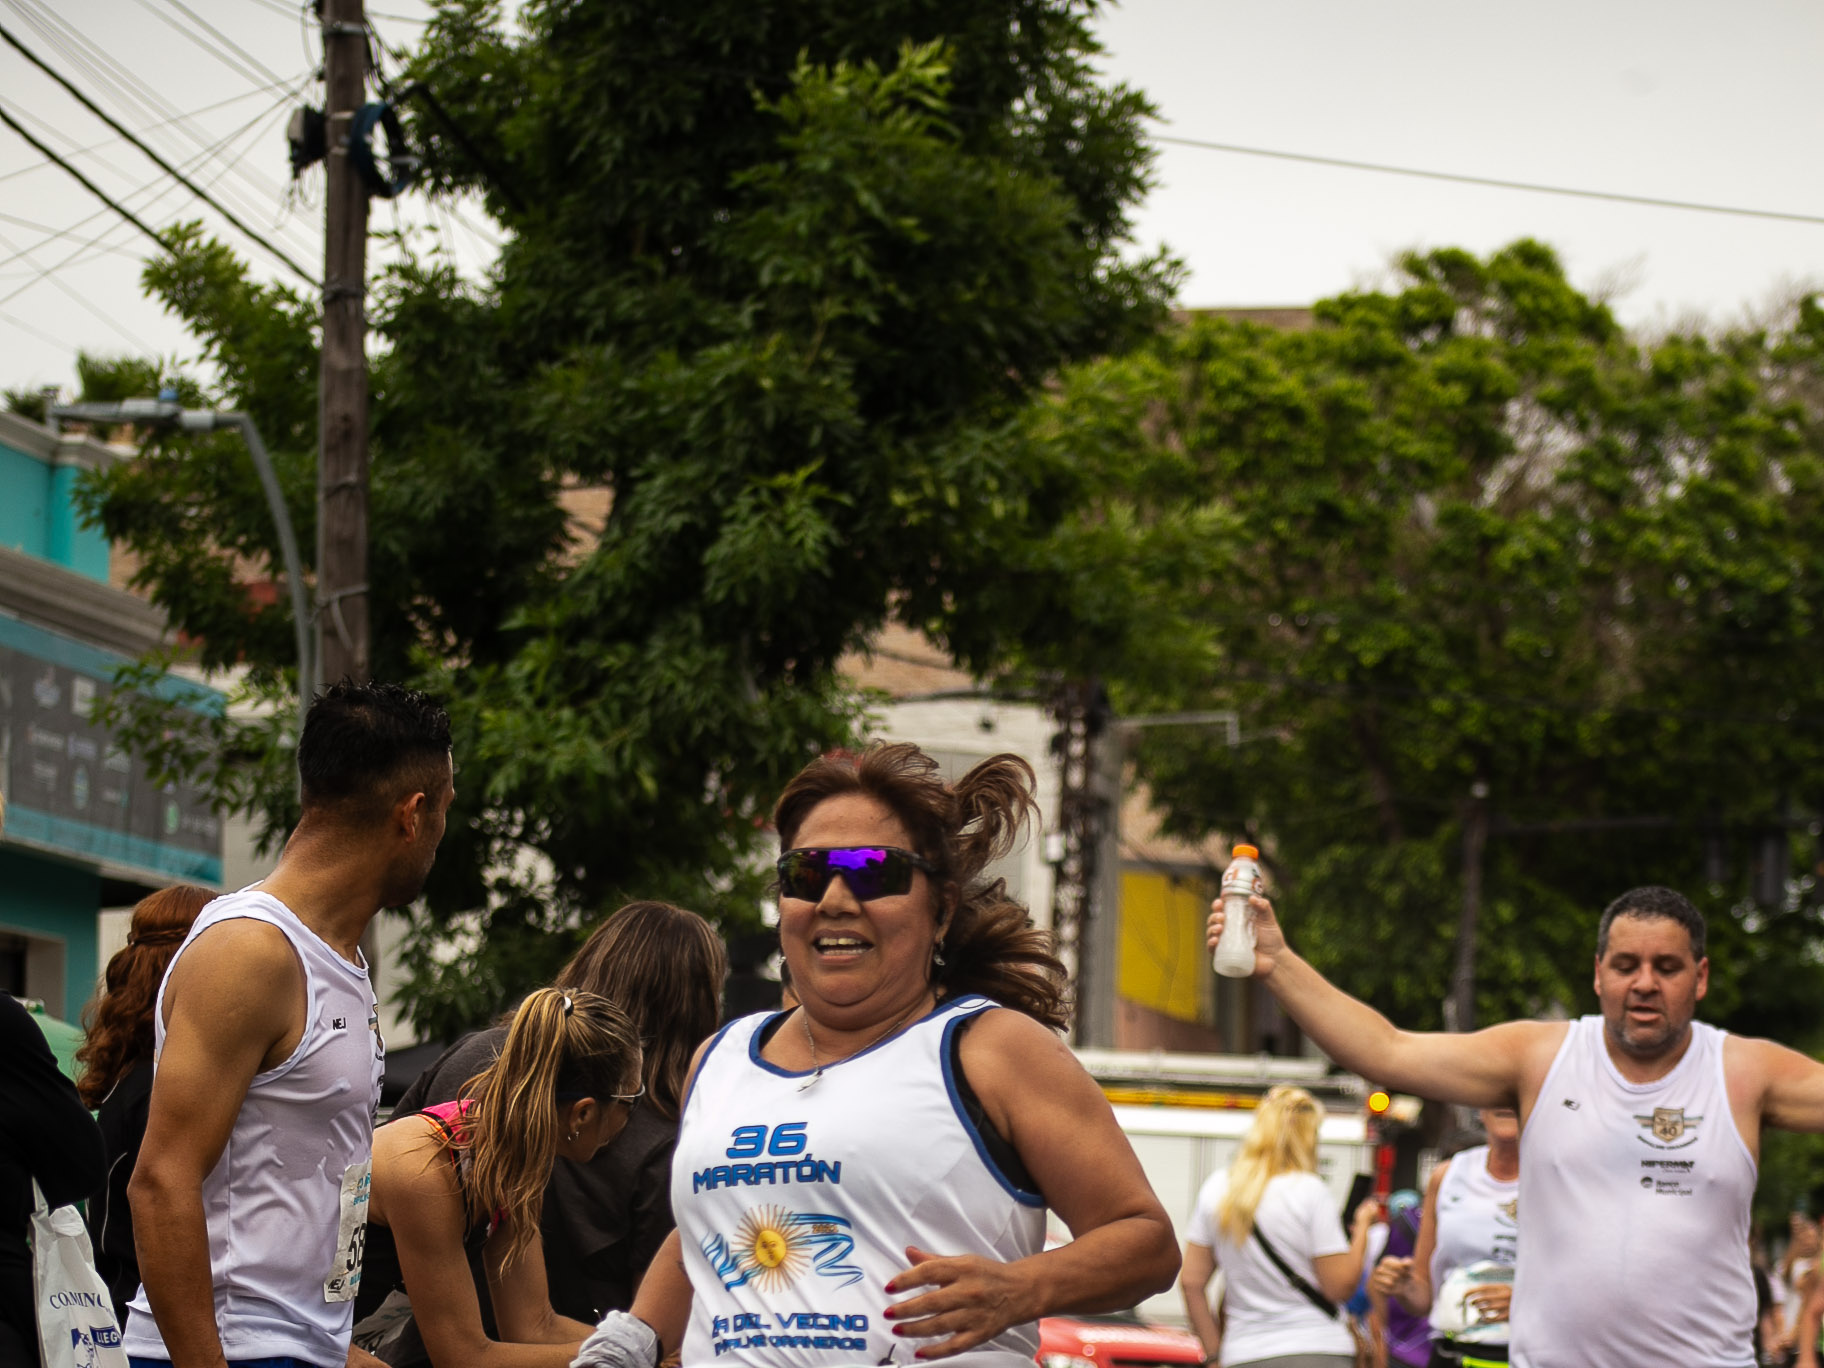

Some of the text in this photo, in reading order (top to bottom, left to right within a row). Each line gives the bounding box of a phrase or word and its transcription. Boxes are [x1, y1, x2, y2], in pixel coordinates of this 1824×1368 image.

[726, 1121, 809, 1159] 36
[692, 1153, 842, 1195] MARATÓN
[733, 1313, 771, 1332] DEL
[775, 1313, 869, 1333] VECINO
